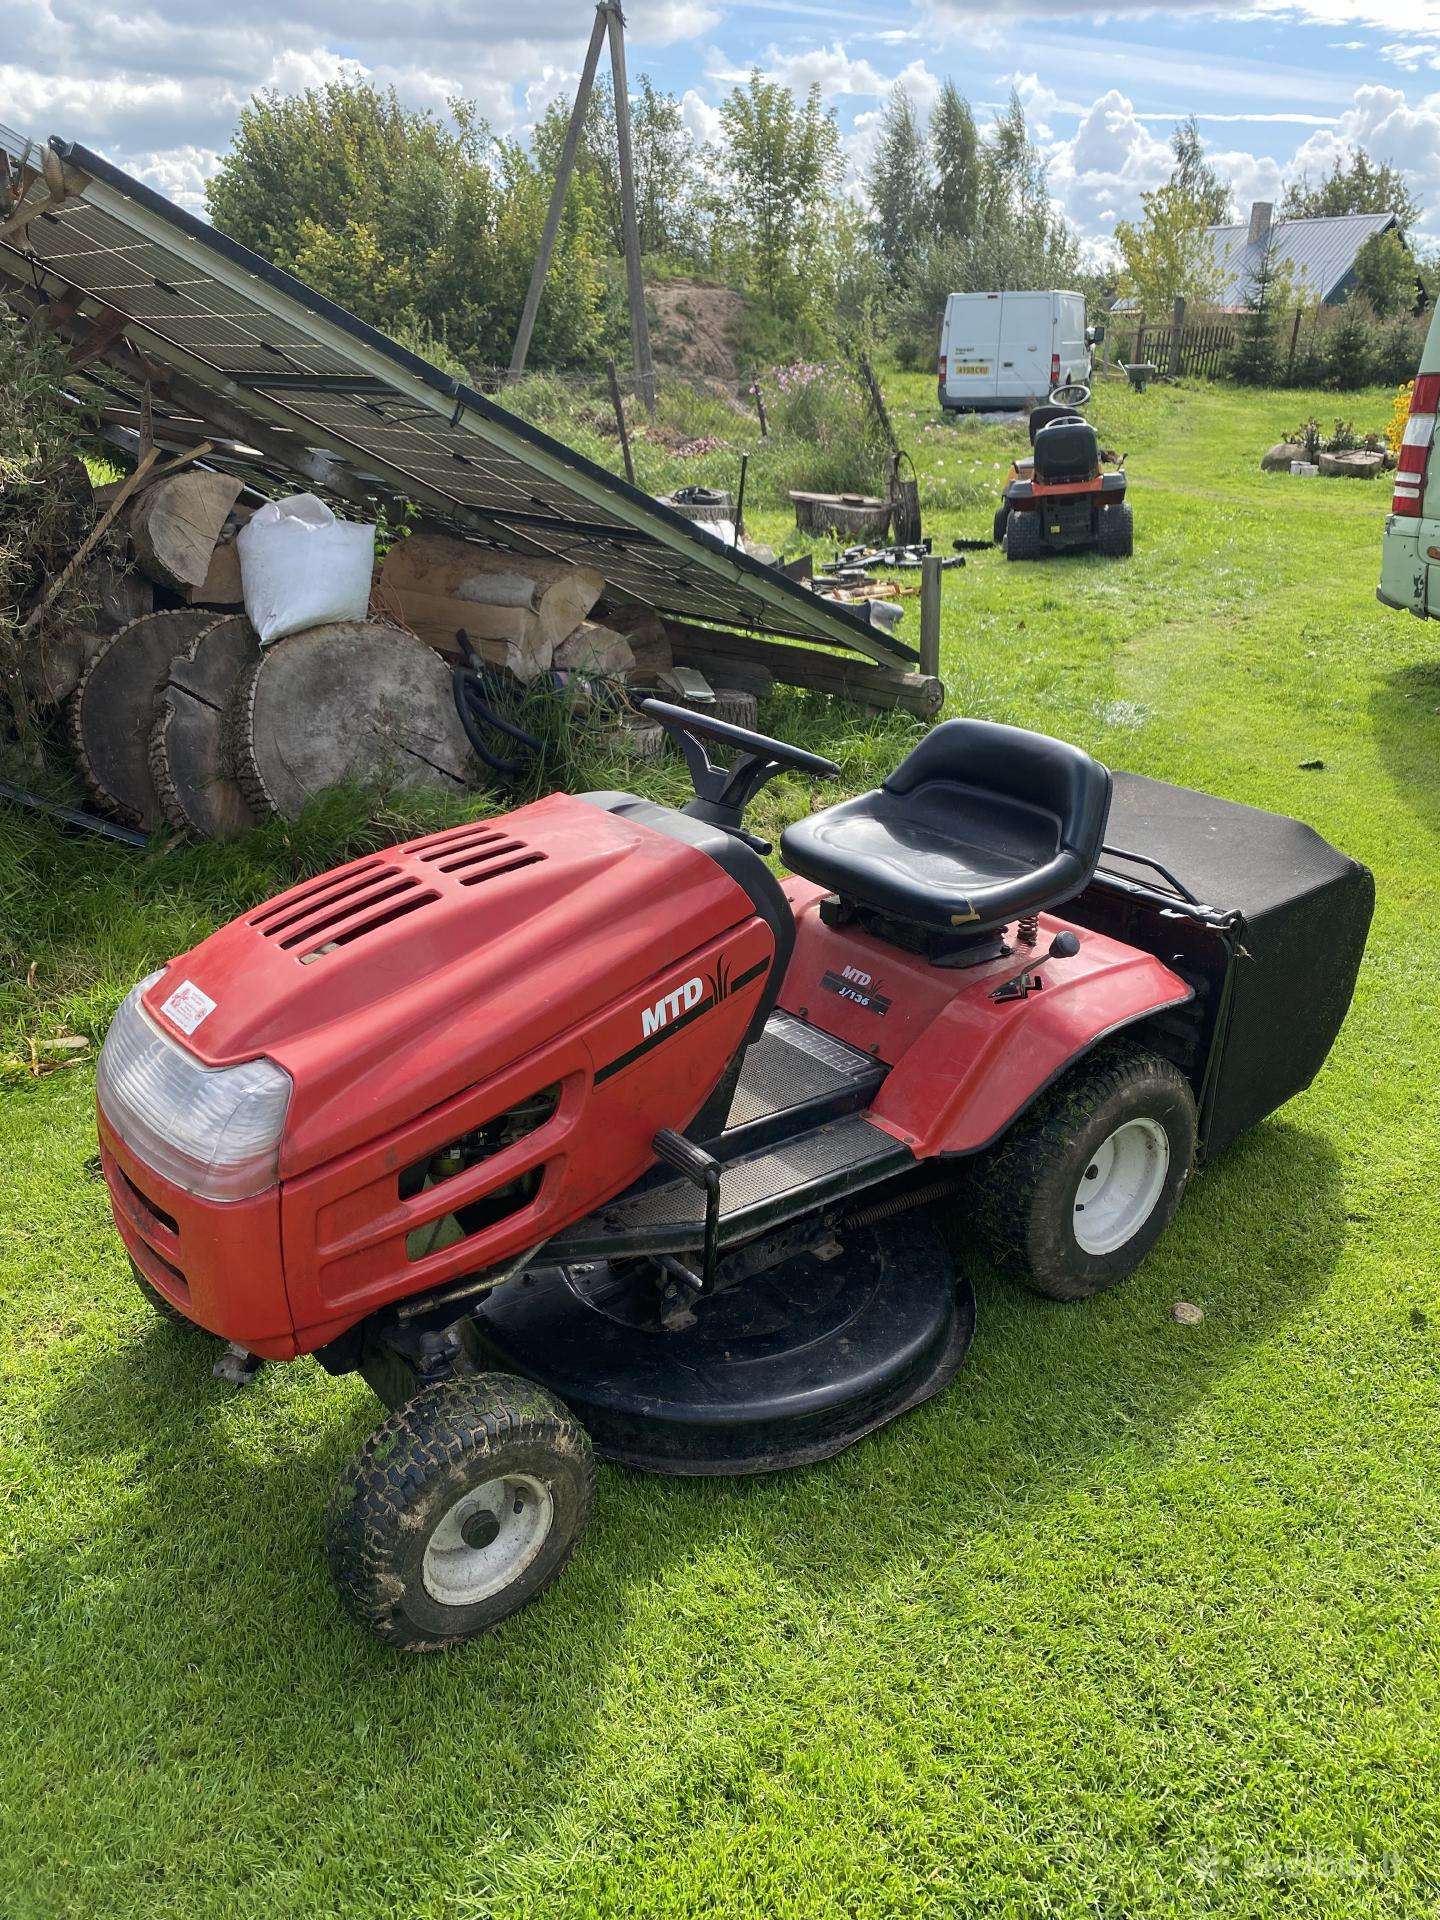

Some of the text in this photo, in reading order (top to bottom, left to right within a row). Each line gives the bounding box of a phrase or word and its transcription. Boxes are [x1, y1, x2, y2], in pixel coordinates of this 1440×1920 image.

[842, 965, 872, 986] MTD
[838, 986, 870, 1006] J/136
[641, 977, 703, 1038] MTD
